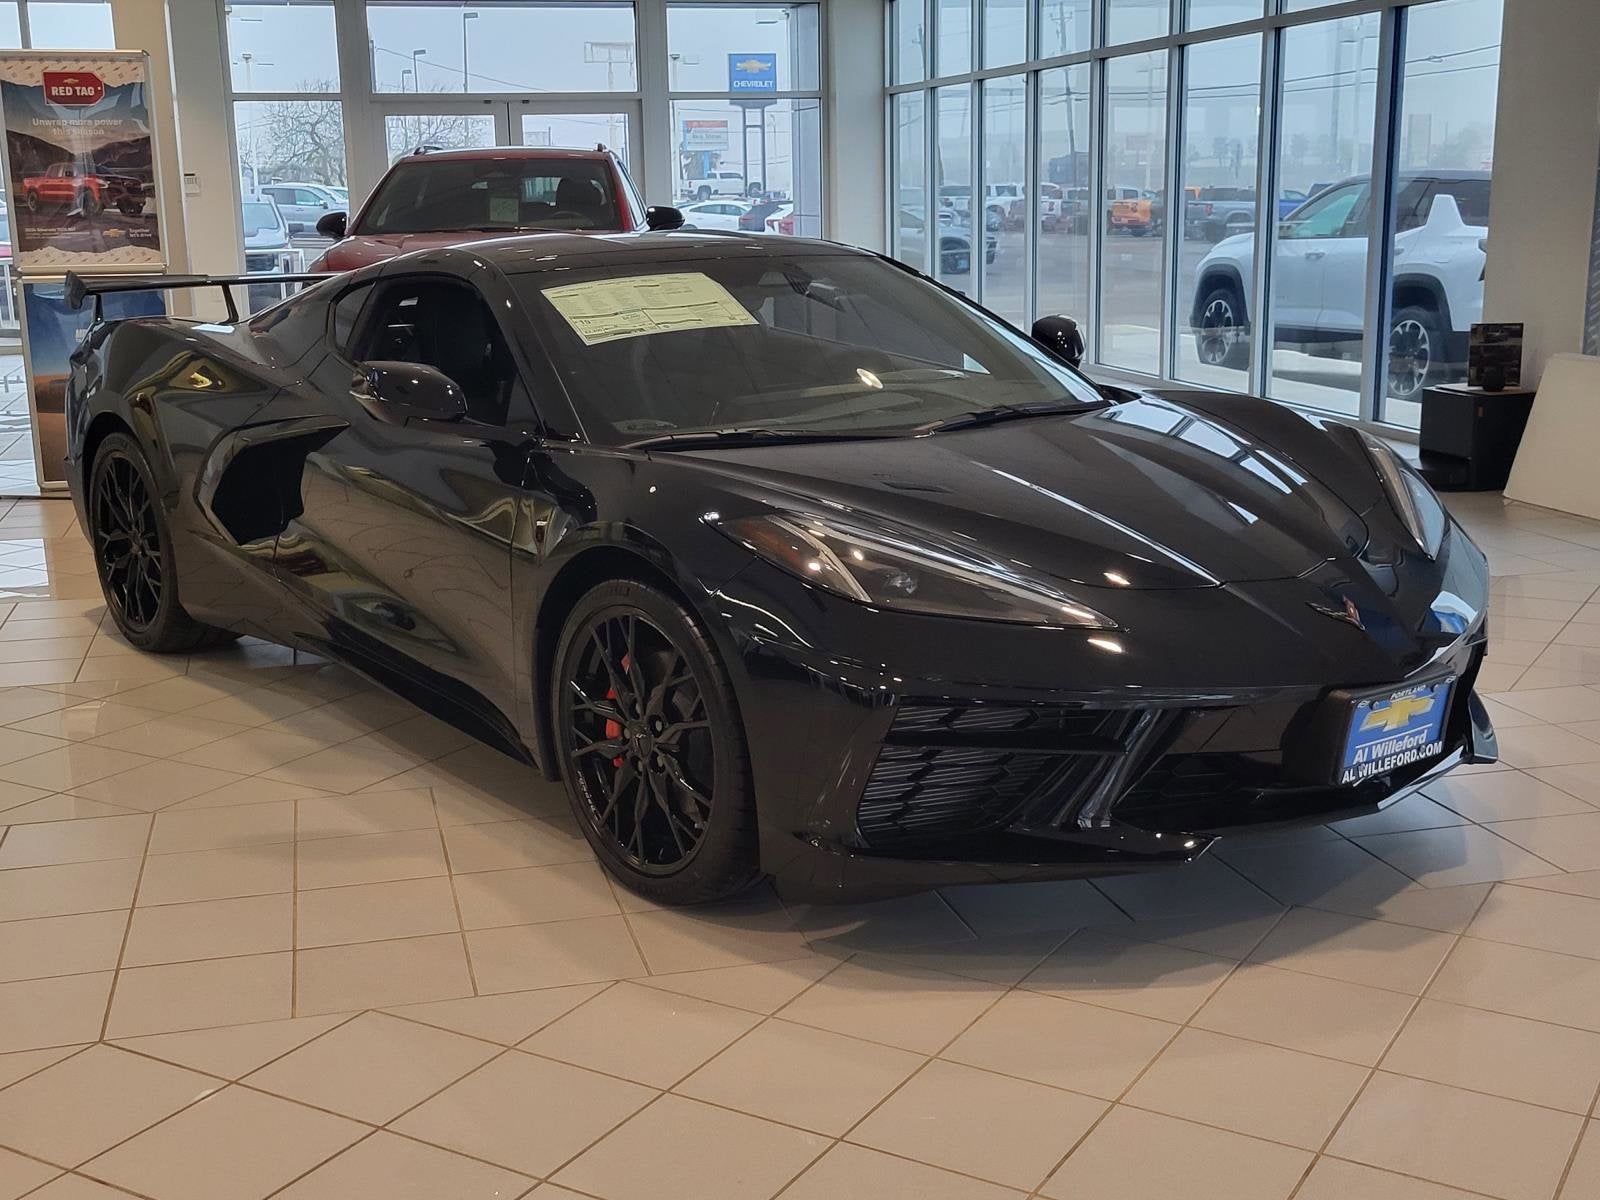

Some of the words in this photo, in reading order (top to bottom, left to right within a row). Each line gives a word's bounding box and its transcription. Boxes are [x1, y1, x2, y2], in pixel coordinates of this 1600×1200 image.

[733, 80, 773, 88] CHEVROLET
[51, 86, 73, 96] RED
[74, 86, 95, 96] TAG
[32, 117, 67, 128] Unwrap
[69, 118, 93, 127] more
[94, 118, 123, 129] power
[1371, 729, 1428, 759] Willeford
[1341, 768, 1356, 784] AL
[1358, 741, 1443, 778] WILLEFORD.COM
